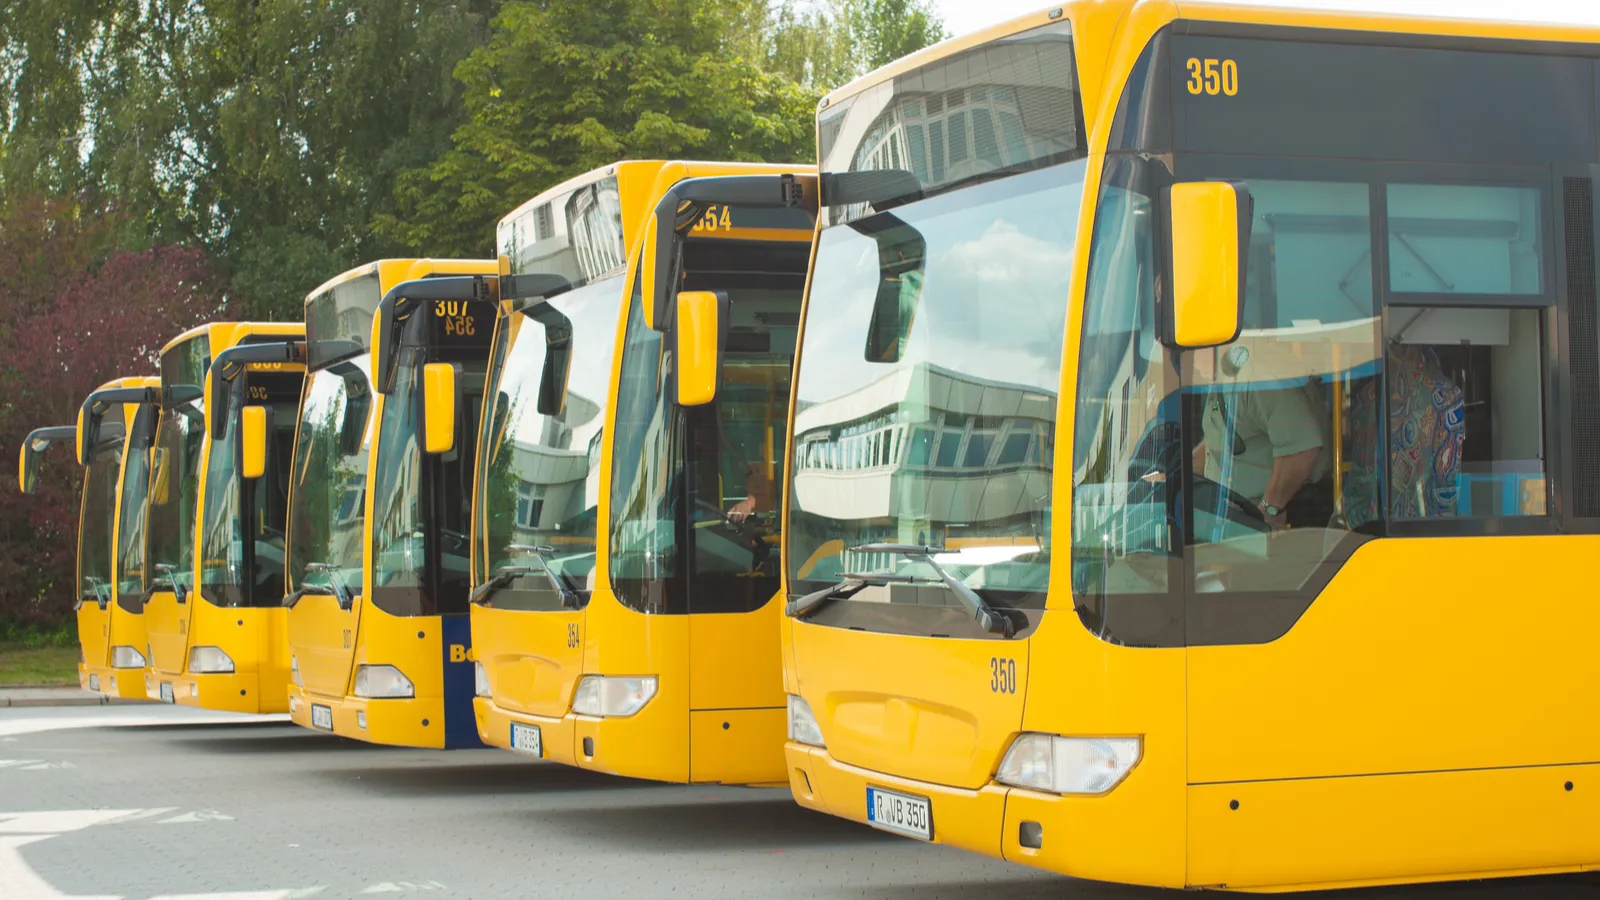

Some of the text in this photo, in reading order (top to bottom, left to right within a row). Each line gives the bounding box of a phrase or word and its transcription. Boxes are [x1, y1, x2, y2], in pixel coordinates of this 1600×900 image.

[1186, 58, 1238, 97] 350
[435, 300, 468, 317] 307
[567, 623, 580, 649] 354
[990, 657, 1016, 695] 350
[876, 794, 927, 831] R VB 350
